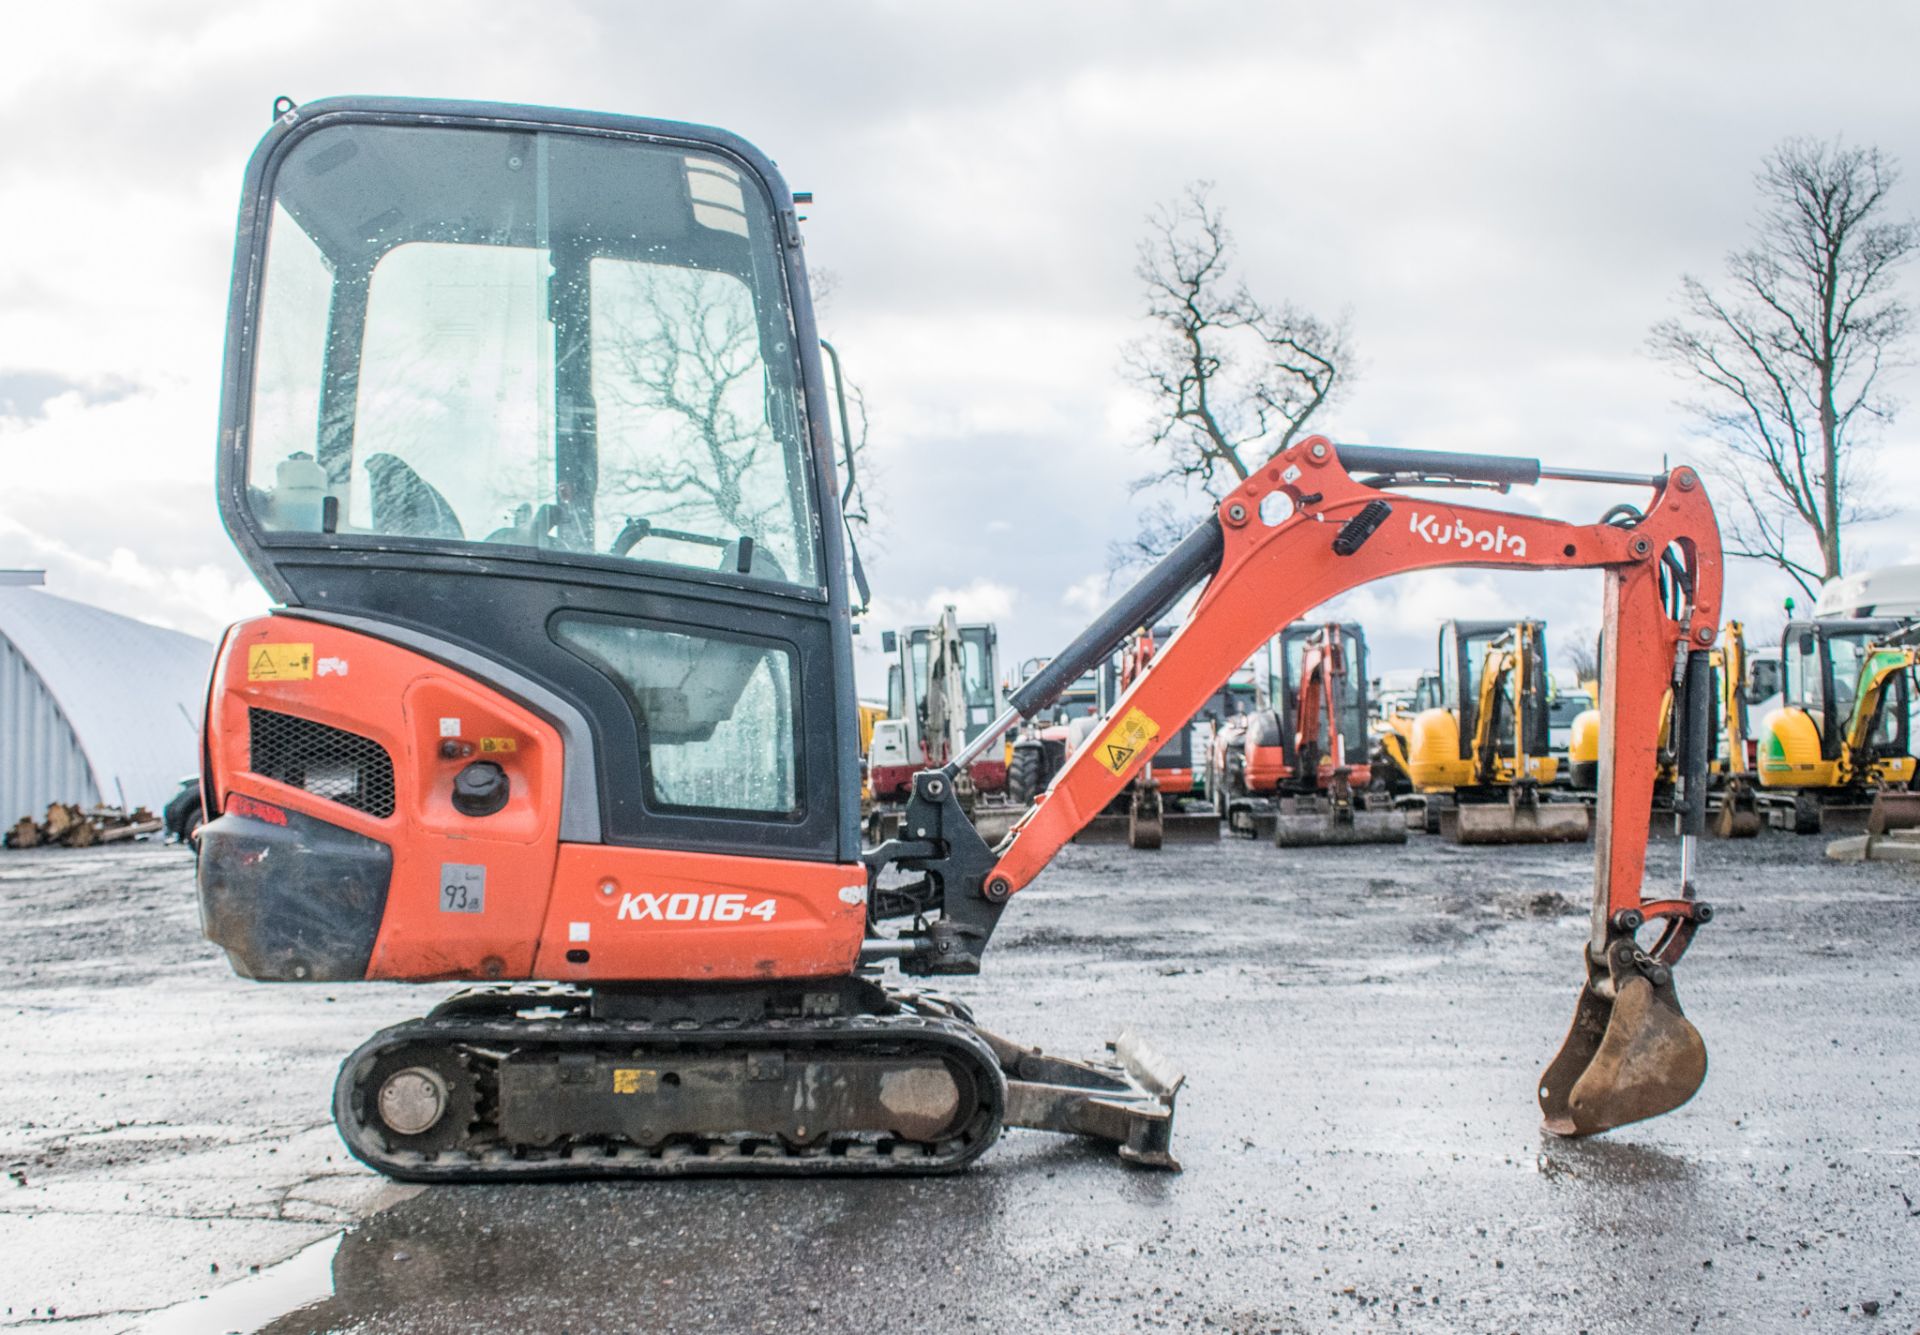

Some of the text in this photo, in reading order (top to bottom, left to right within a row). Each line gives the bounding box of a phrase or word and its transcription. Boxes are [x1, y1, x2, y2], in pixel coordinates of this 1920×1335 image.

[1409, 512, 1527, 557] Kubota
[445, 885, 468, 909] 93
[617, 892, 777, 922] KX016-4
